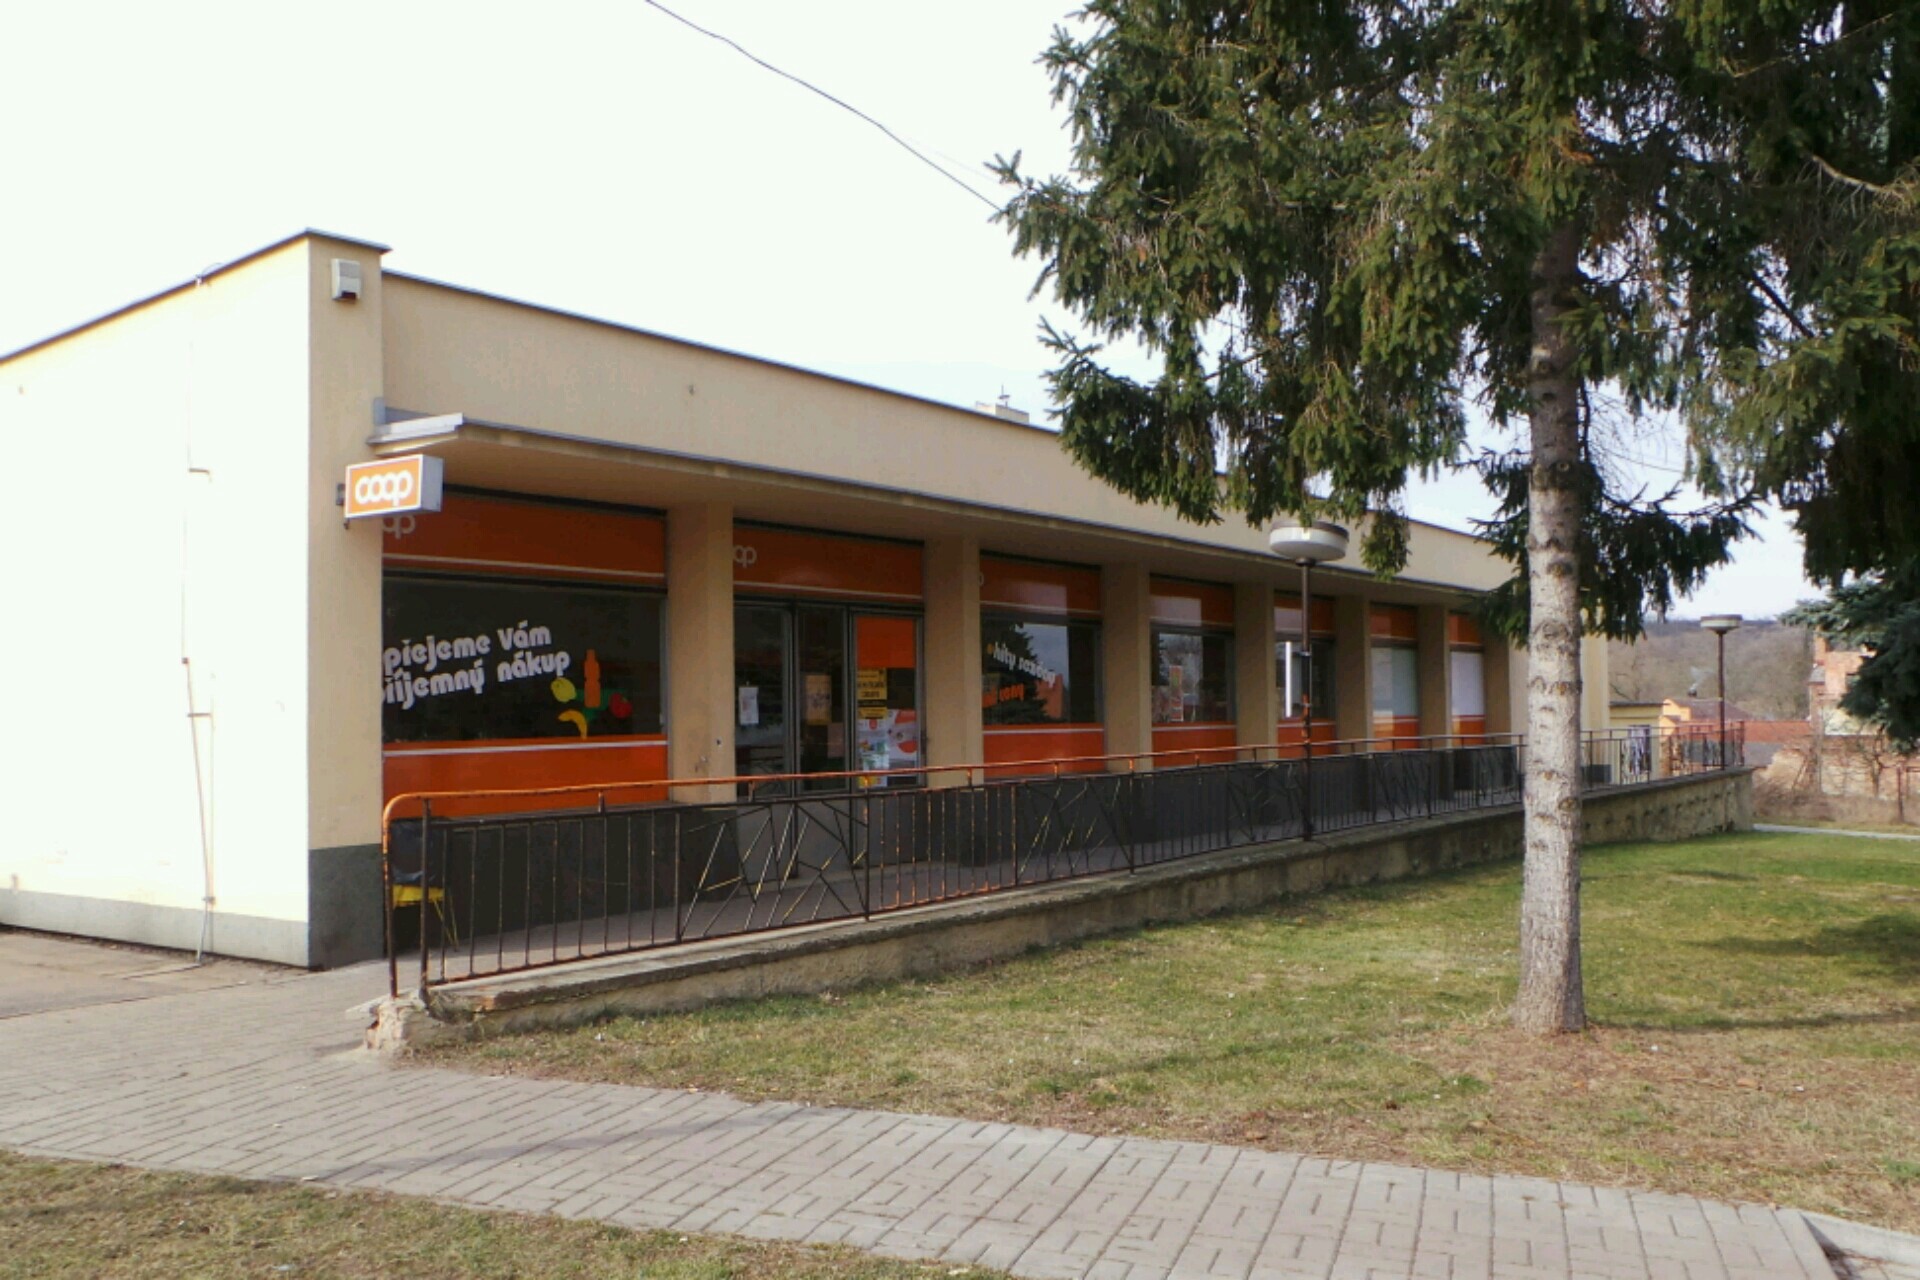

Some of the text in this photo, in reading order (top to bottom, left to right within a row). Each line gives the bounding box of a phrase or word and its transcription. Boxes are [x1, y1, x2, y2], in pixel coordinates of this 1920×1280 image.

[355, 469, 414, 507] coop
[496, 619, 552, 651] Vám
[381, 650, 571, 710] říjemný nákup
